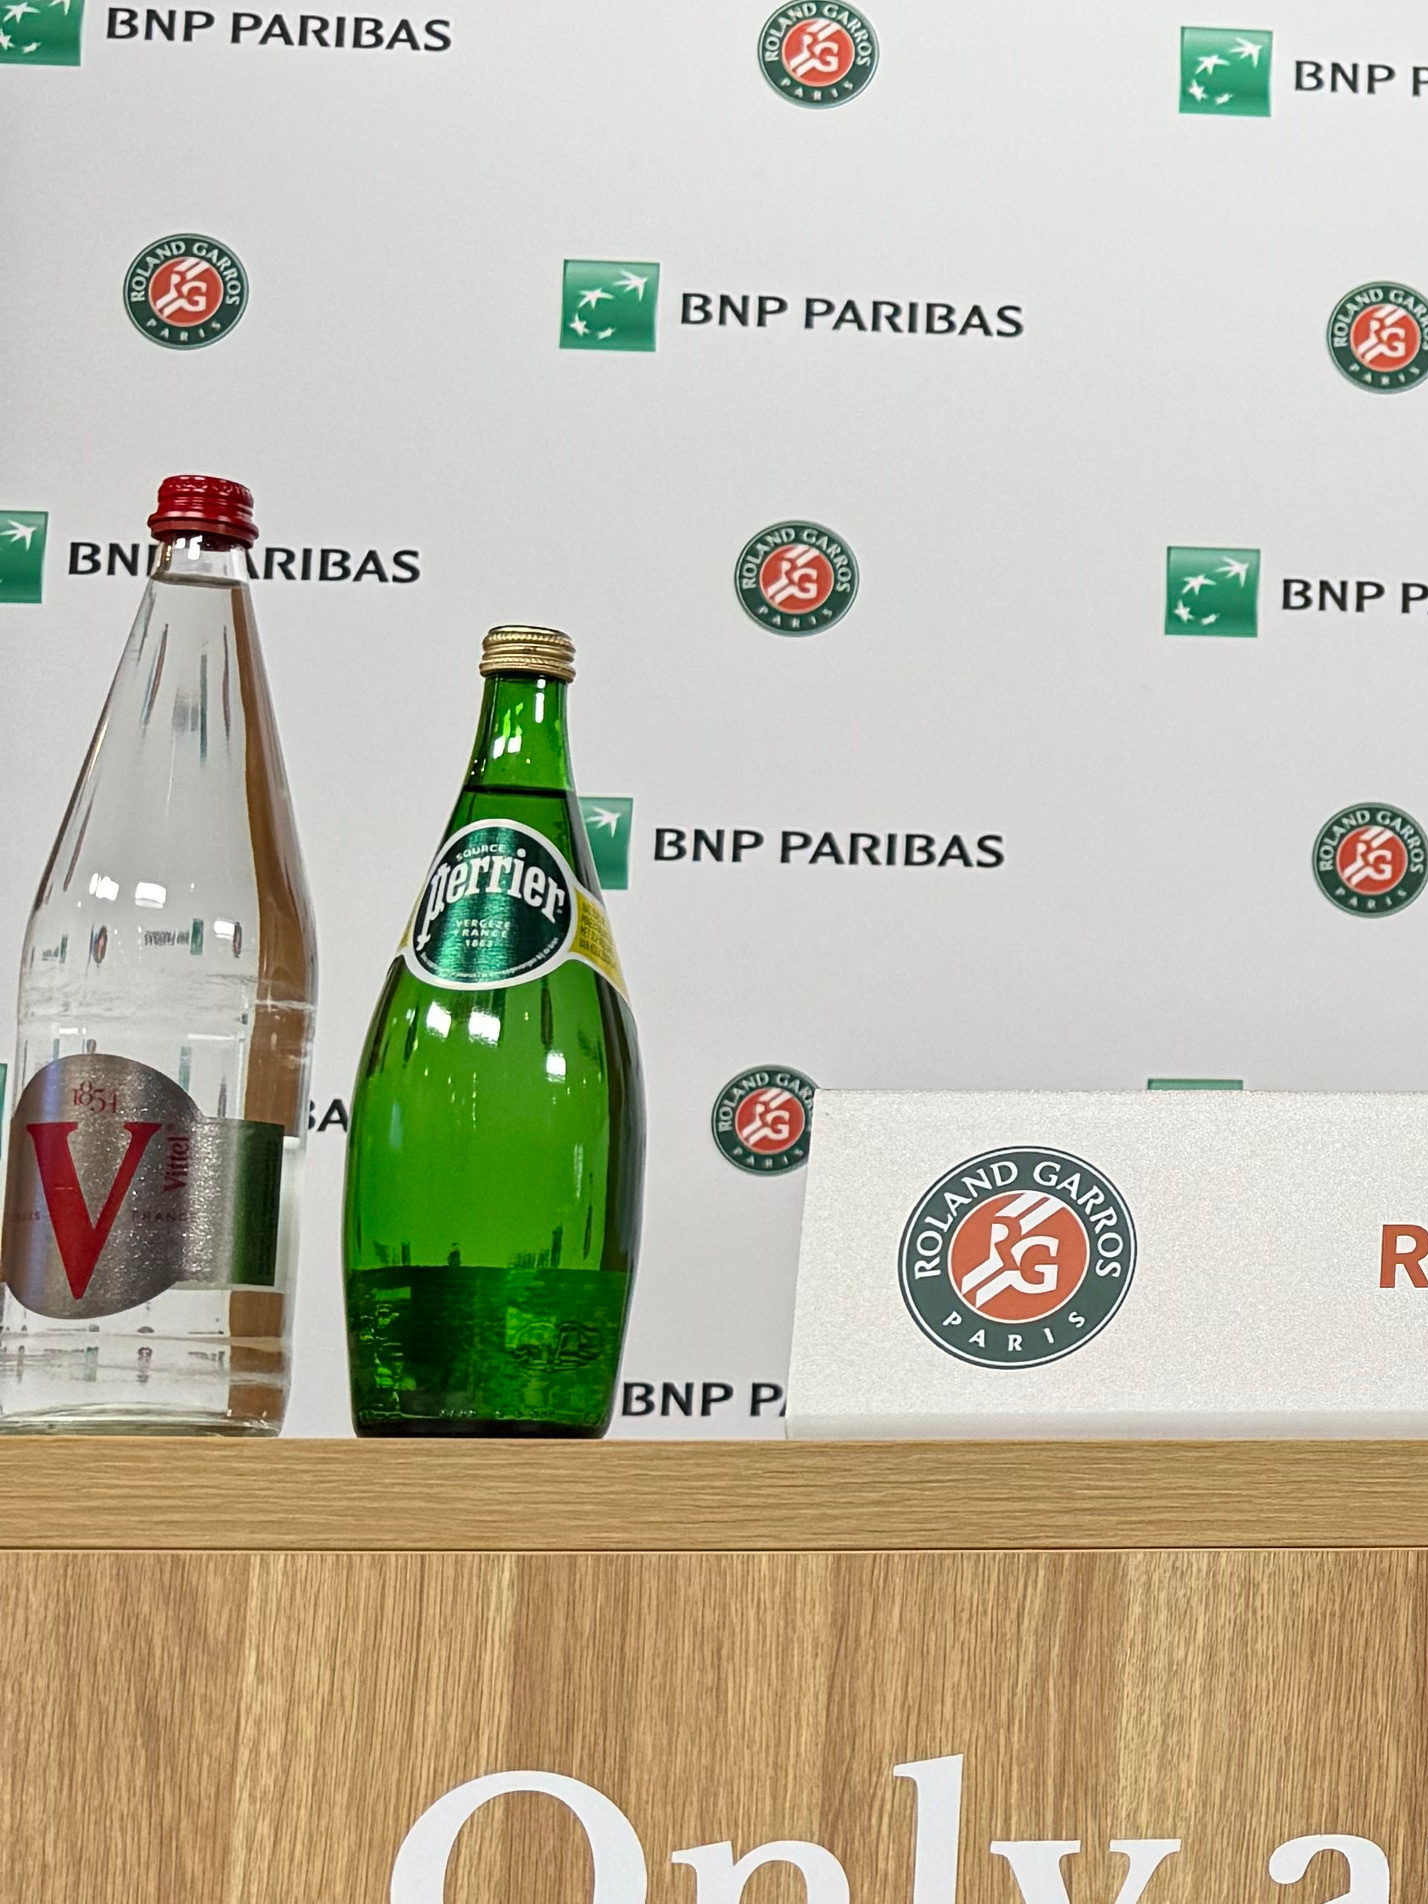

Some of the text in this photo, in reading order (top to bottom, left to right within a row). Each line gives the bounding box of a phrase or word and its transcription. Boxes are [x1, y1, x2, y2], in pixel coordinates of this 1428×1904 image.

[106, 7, 452, 52] BNP PARIBAS
[764, 2, 872, 66] ROLAND GARROS
[1294, 60, 1396, 95] BNP
[130, 240, 242, 305] ROLAND GARROS
[680, 292, 1023, 338] BNP PARIBAS
[1332, 288, 1384, 348] ROLAND
[245, 546, 421, 584] RIBAS
[741, 527, 852, 592] ROLAND GARROS
[1282, 578, 1385, 613] BNP
[455, 844, 509, 860] SOURCE
[653, 827, 1005, 869] BNP PARIBAS
[1318, 809, 1425, 873] ROLAND GARROS
[718, 1071, 769, 1132] ROLAND
[162, 1136, 191, 1194] Vittel
[26, 1121, 162, 1301] V
[914, 1161, 1124, 1280] ROLAND GARROS
[942, 1310, 1086, 1352] PARIS
[621, 1381, 735, 1418] BNP
